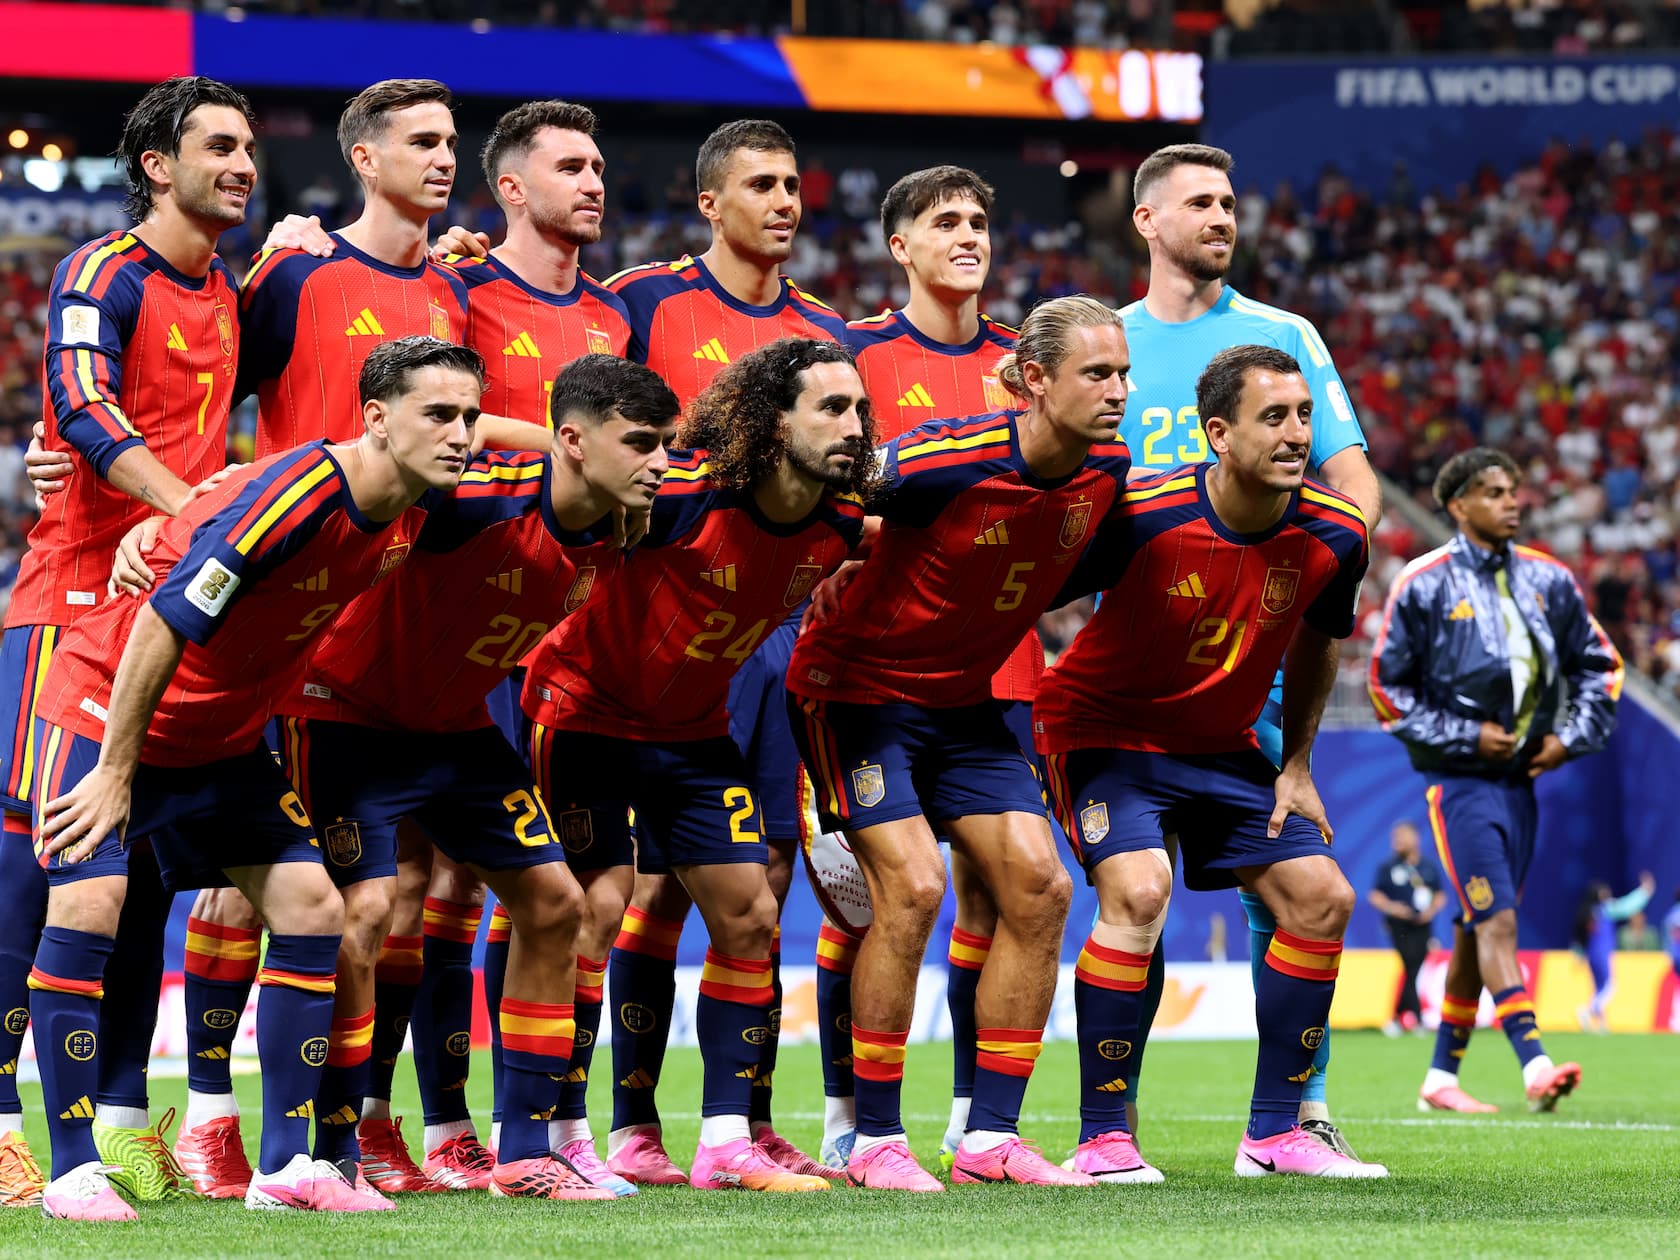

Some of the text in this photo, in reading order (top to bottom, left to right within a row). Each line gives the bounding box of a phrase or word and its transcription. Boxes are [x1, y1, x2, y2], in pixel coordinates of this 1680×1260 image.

[1335, 65, 1677, 106] FIFA WORLD CUP
[197, 372, 213, 435] 7
[1141, 406, 1208, 464] 23
[994, 562, 1036, 611] 5
[285, 603, 340, 641] 9
[464, 614, 548, 669] 20
[684, 611, 768, 666] 24
[1186, 617, 1247, 673] 21
[723, 787, 766, 843] 2
[840, 863, 859, 875] REAL
[73, 1045, 91, 1053] EF
[74, 1036, 91, 1045] RF
[309, 1051, 325, 1060] EF
[310, 1043, 327, 1051] RF
